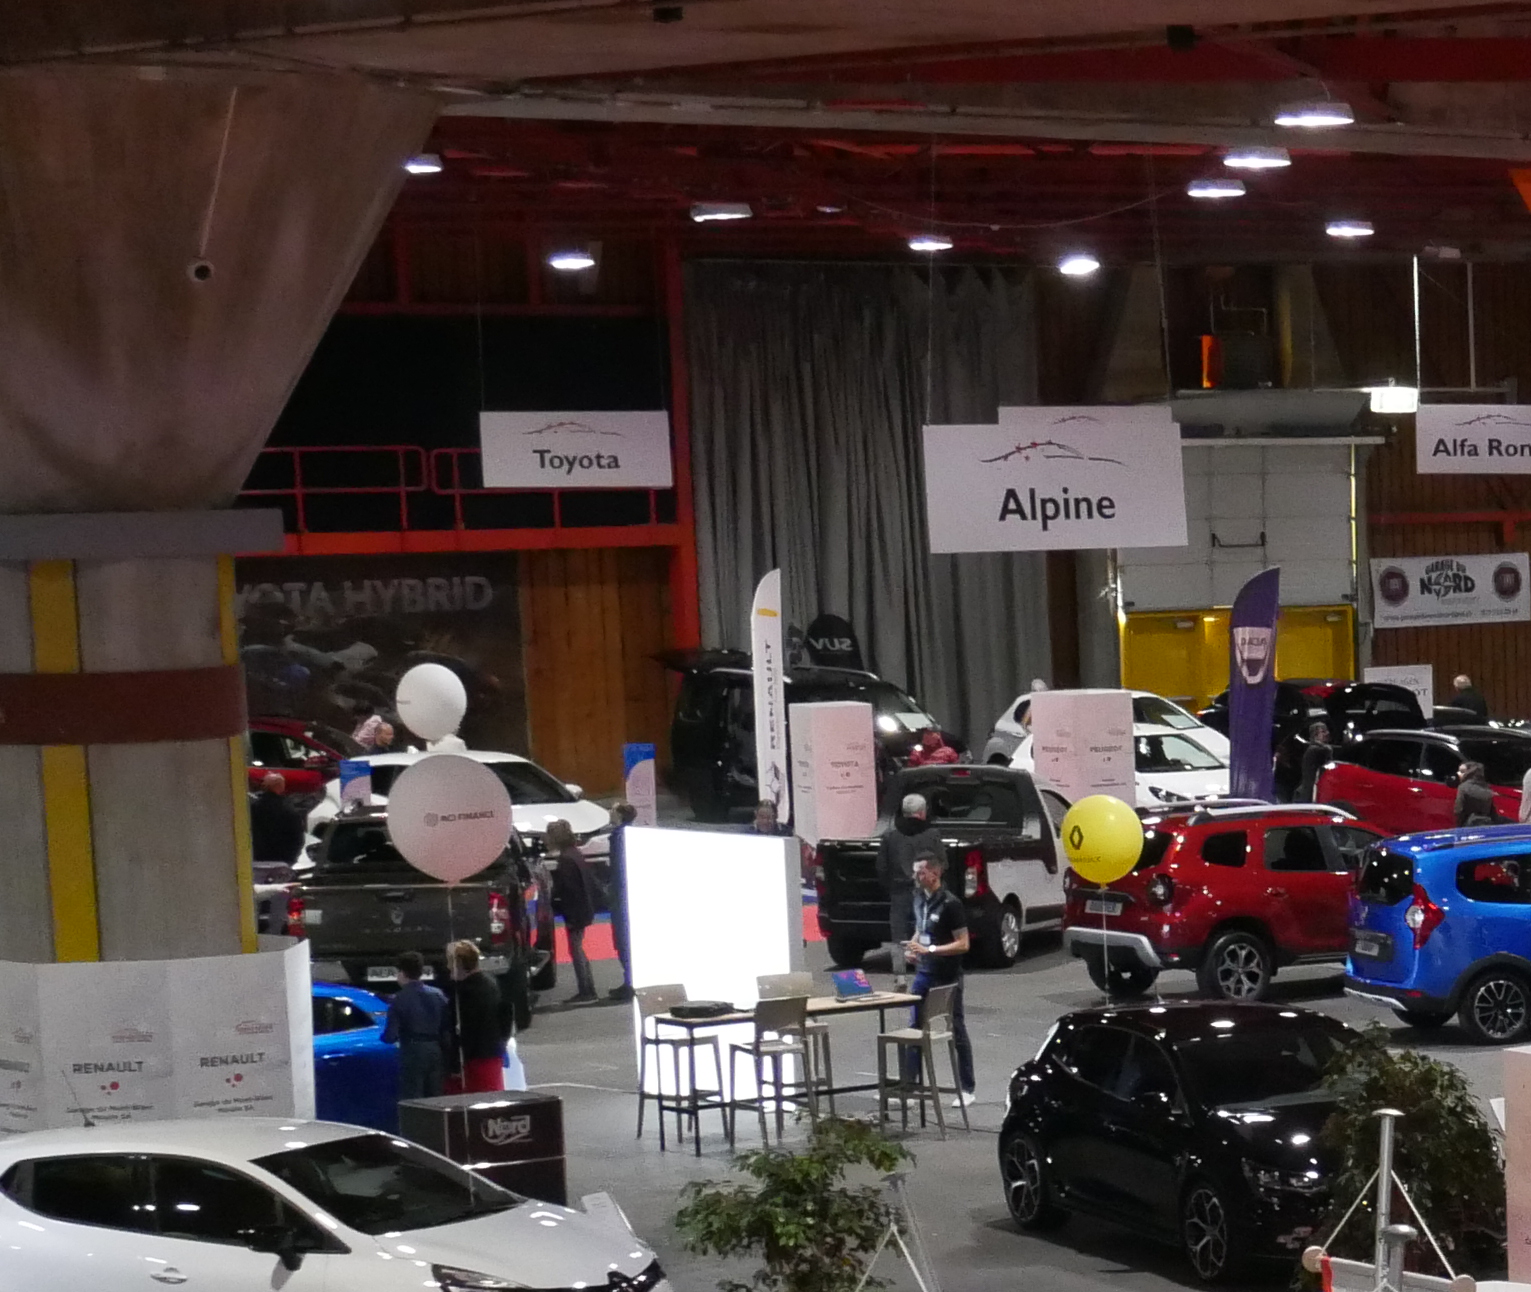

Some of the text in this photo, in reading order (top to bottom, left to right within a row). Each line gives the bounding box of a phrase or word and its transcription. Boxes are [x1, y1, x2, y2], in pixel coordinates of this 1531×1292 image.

[1432, 438, 1479, 457] Alfa
[532, 448, 621, 476] Toyota
[998, 486, 1117, 532] Alpine
[343, 576, 495, 613] HYBRID
[72, 1060, 144, 1074] RENAULT
[199, 1052, 266, 1068] RENAULT
[488, 1114, 532, 1137] Nord
